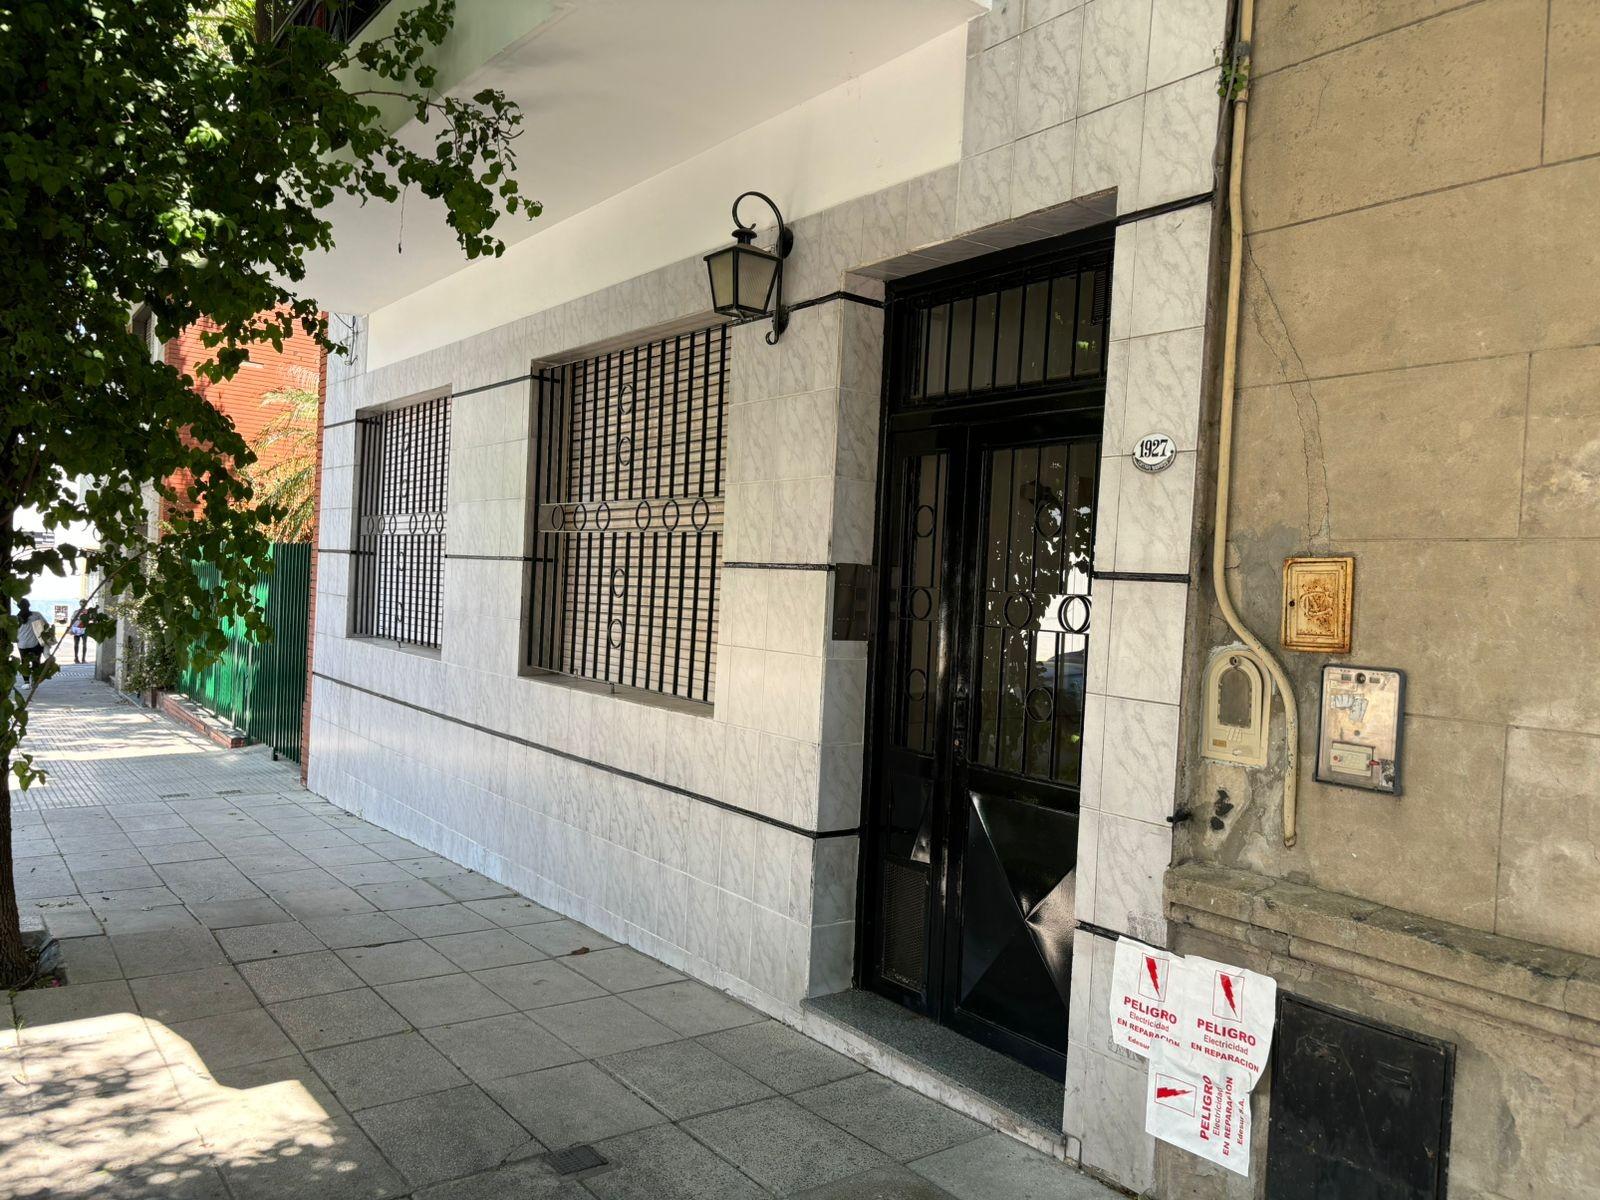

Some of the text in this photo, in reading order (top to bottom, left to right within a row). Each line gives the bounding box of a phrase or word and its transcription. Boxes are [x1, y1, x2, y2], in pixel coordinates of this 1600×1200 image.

[1139, 438, 1168, 458] 1927
[1117, 1016, 1128, 1028] EN
[1123, 995, 1177, 1025] PELIGRO
[1129, 1010, 1170, 1032] Electricidad
[1127, 1036, 1150, 1050] Edesur
[1197, 1018, 1256, 1046] PELIGRO
[1204, 1034, 1249, 1055] Electricidad
[1191, 1042, 1259, 1073] EN REPARACION
[1200, 1075, 1213, 1141] PELIGRO
[1213, 1086, 1224, 1136] Electricidad
[1237, 1117, 1245, 1145] Edesur
[1223, 1141, 1230, 1156] EN
